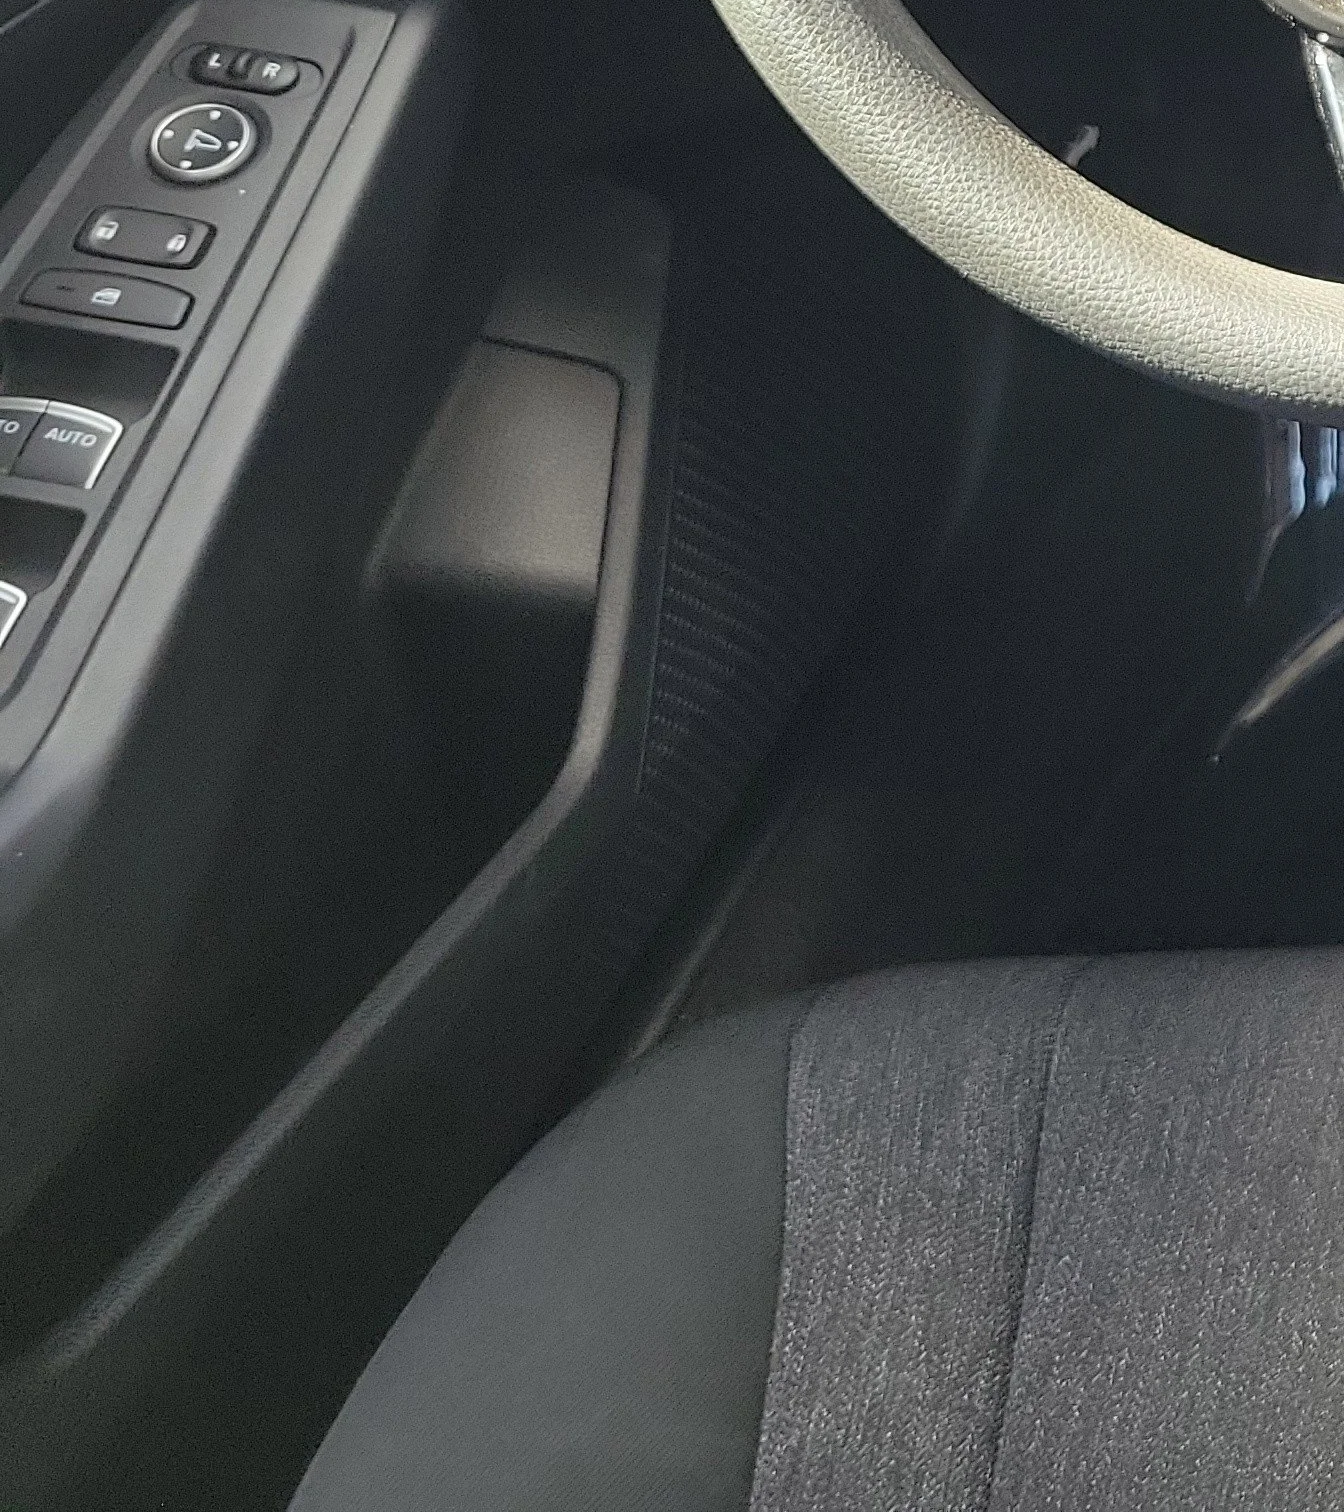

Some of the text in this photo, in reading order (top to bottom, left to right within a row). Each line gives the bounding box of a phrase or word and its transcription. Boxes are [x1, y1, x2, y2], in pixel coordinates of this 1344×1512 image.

[208, 52, 281, 80] L R
[44, 427, 98, 447] AUTO
